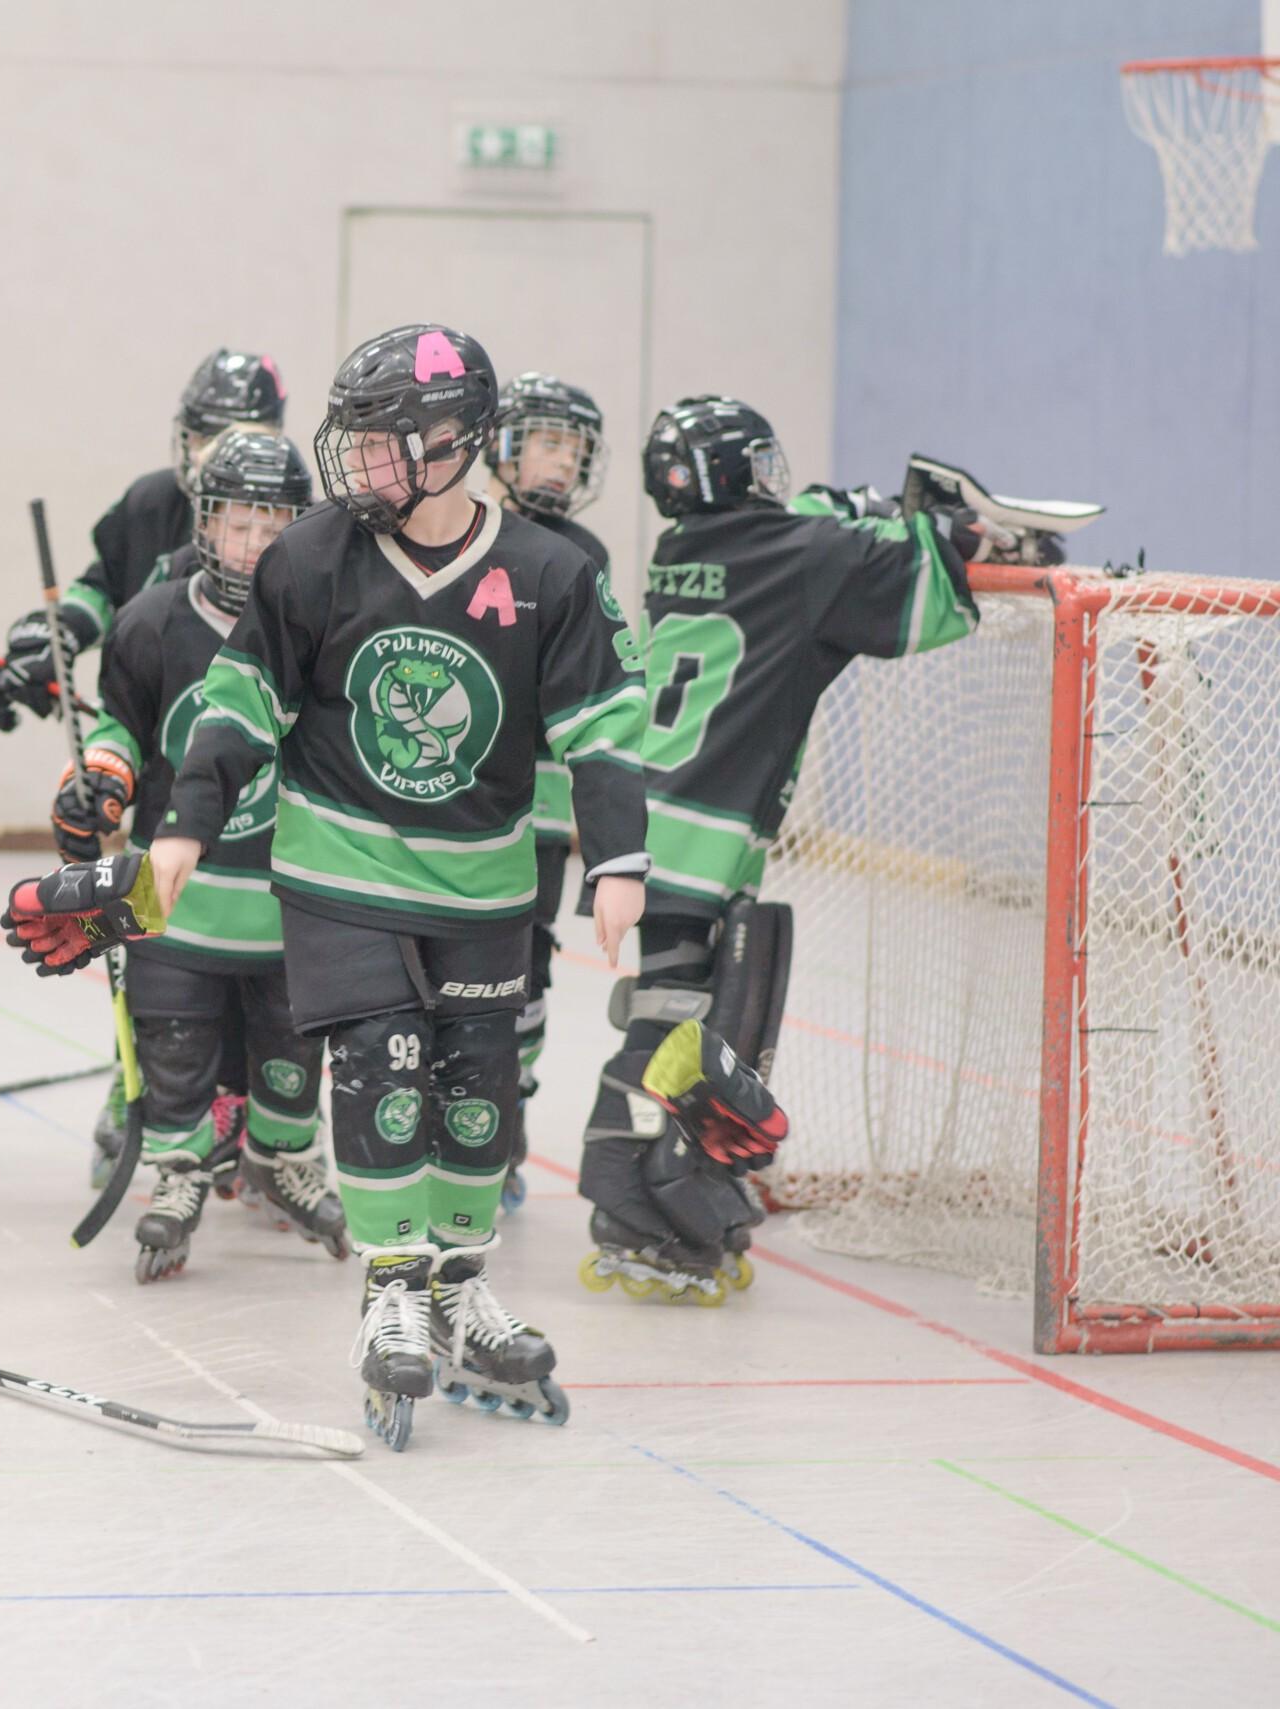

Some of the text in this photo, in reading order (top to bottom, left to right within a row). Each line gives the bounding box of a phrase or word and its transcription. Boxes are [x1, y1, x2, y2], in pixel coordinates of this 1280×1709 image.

[415, 331, 466, 383] A
[466, 567, 517, 627] A
[373, 633, 467, 669] PULHEIM
[379, 761, 466, 795] VIPERS
[440, 974, 526, 998] BAUER
[387, 1033, 421, 1072] 93
